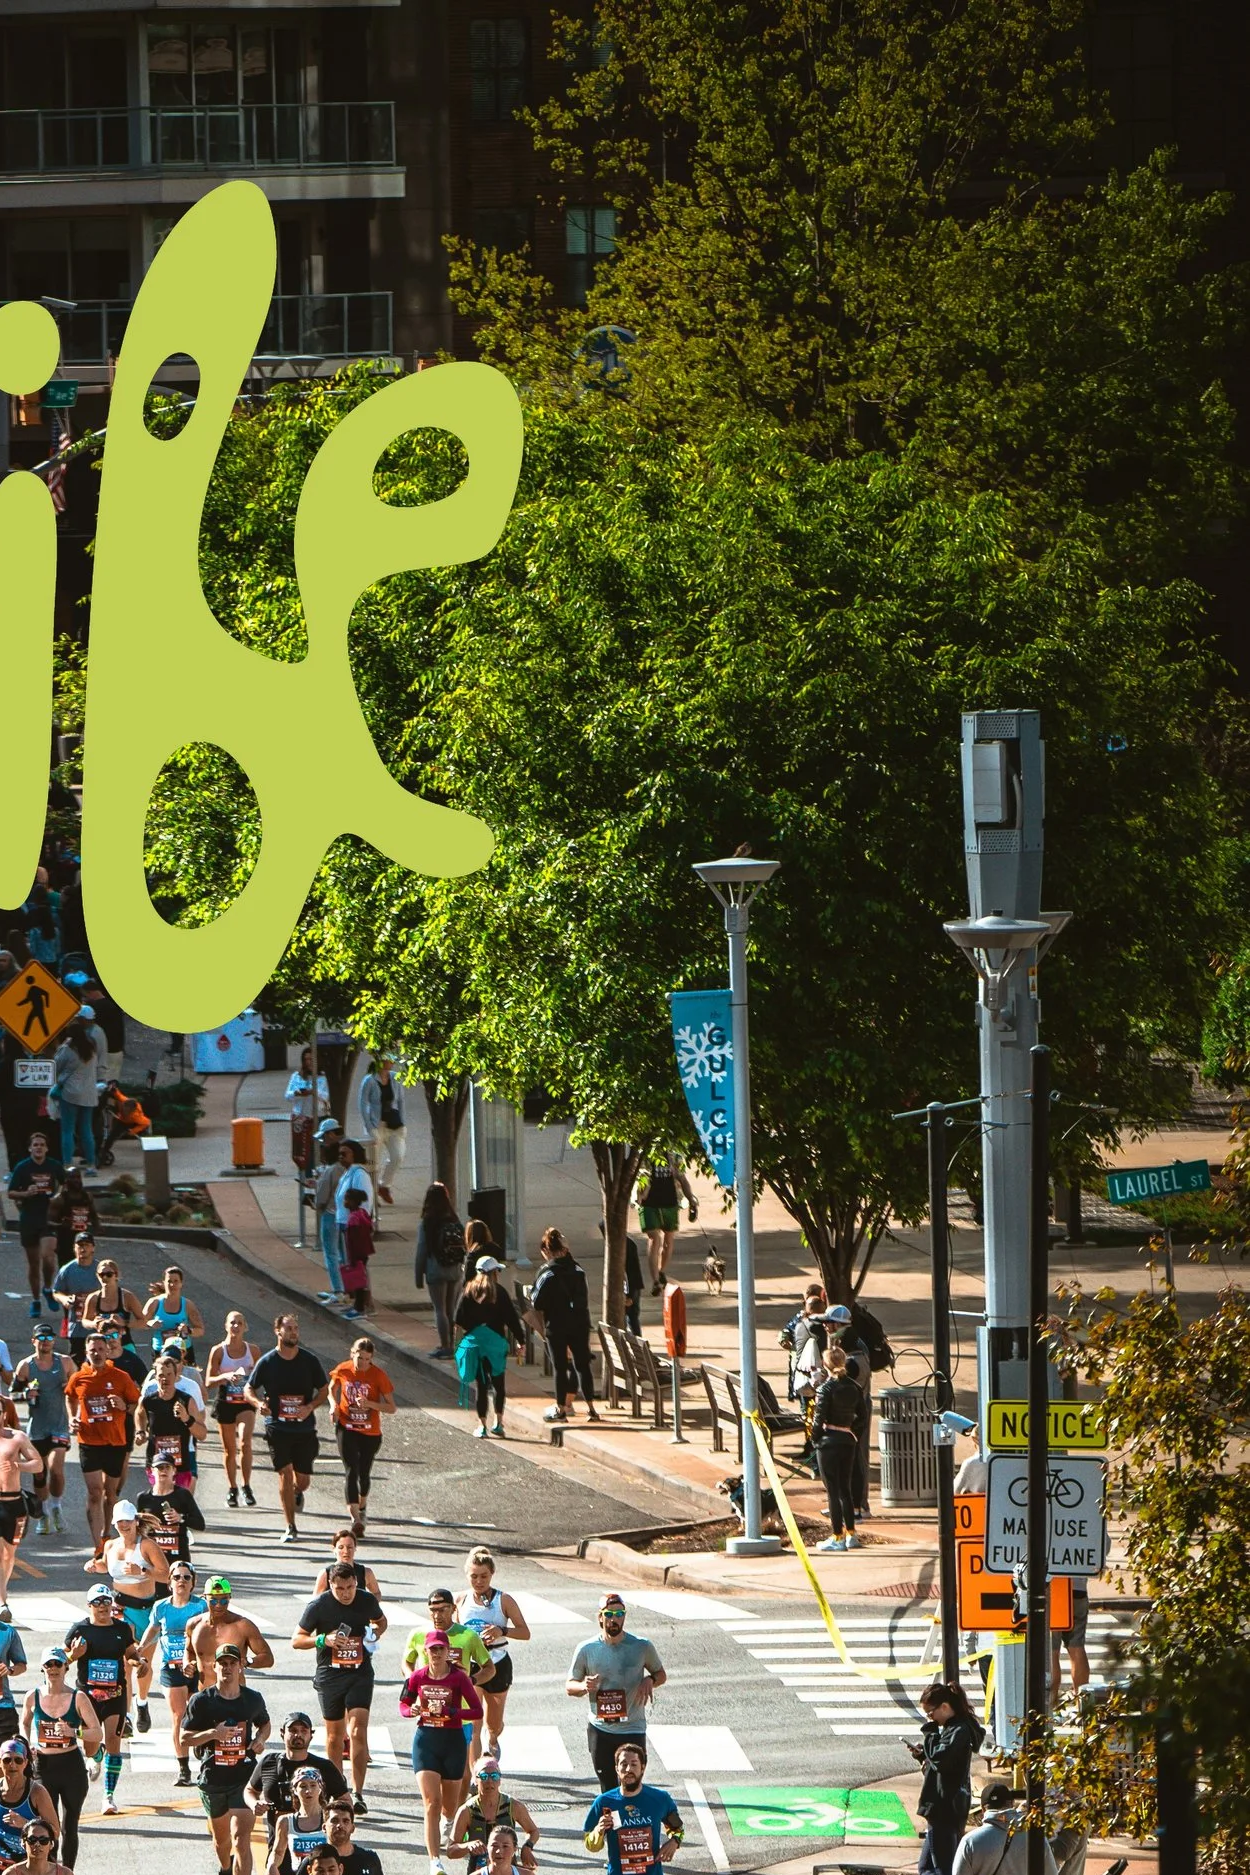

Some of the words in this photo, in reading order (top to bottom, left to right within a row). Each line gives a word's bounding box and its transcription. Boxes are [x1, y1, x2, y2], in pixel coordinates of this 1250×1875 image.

[707, 1026, 728, 1156] GULCH
[1114, 1170, 1182, 1200] LAUREL
[1190, 1174, 1204, 1187] ST
[1003, 1518, 1027, 1535] MA
[1055, 1520, 1088, 1537] USE
[993, 1546, 1023, 1563] FUL
[1052, 1547, 1096, 1565] LANE
[92, 1671, 114, 1679] 21326
[623, 1816, 652, 1826] ANSAS
[623, 1842, 650, 1851] 14142
